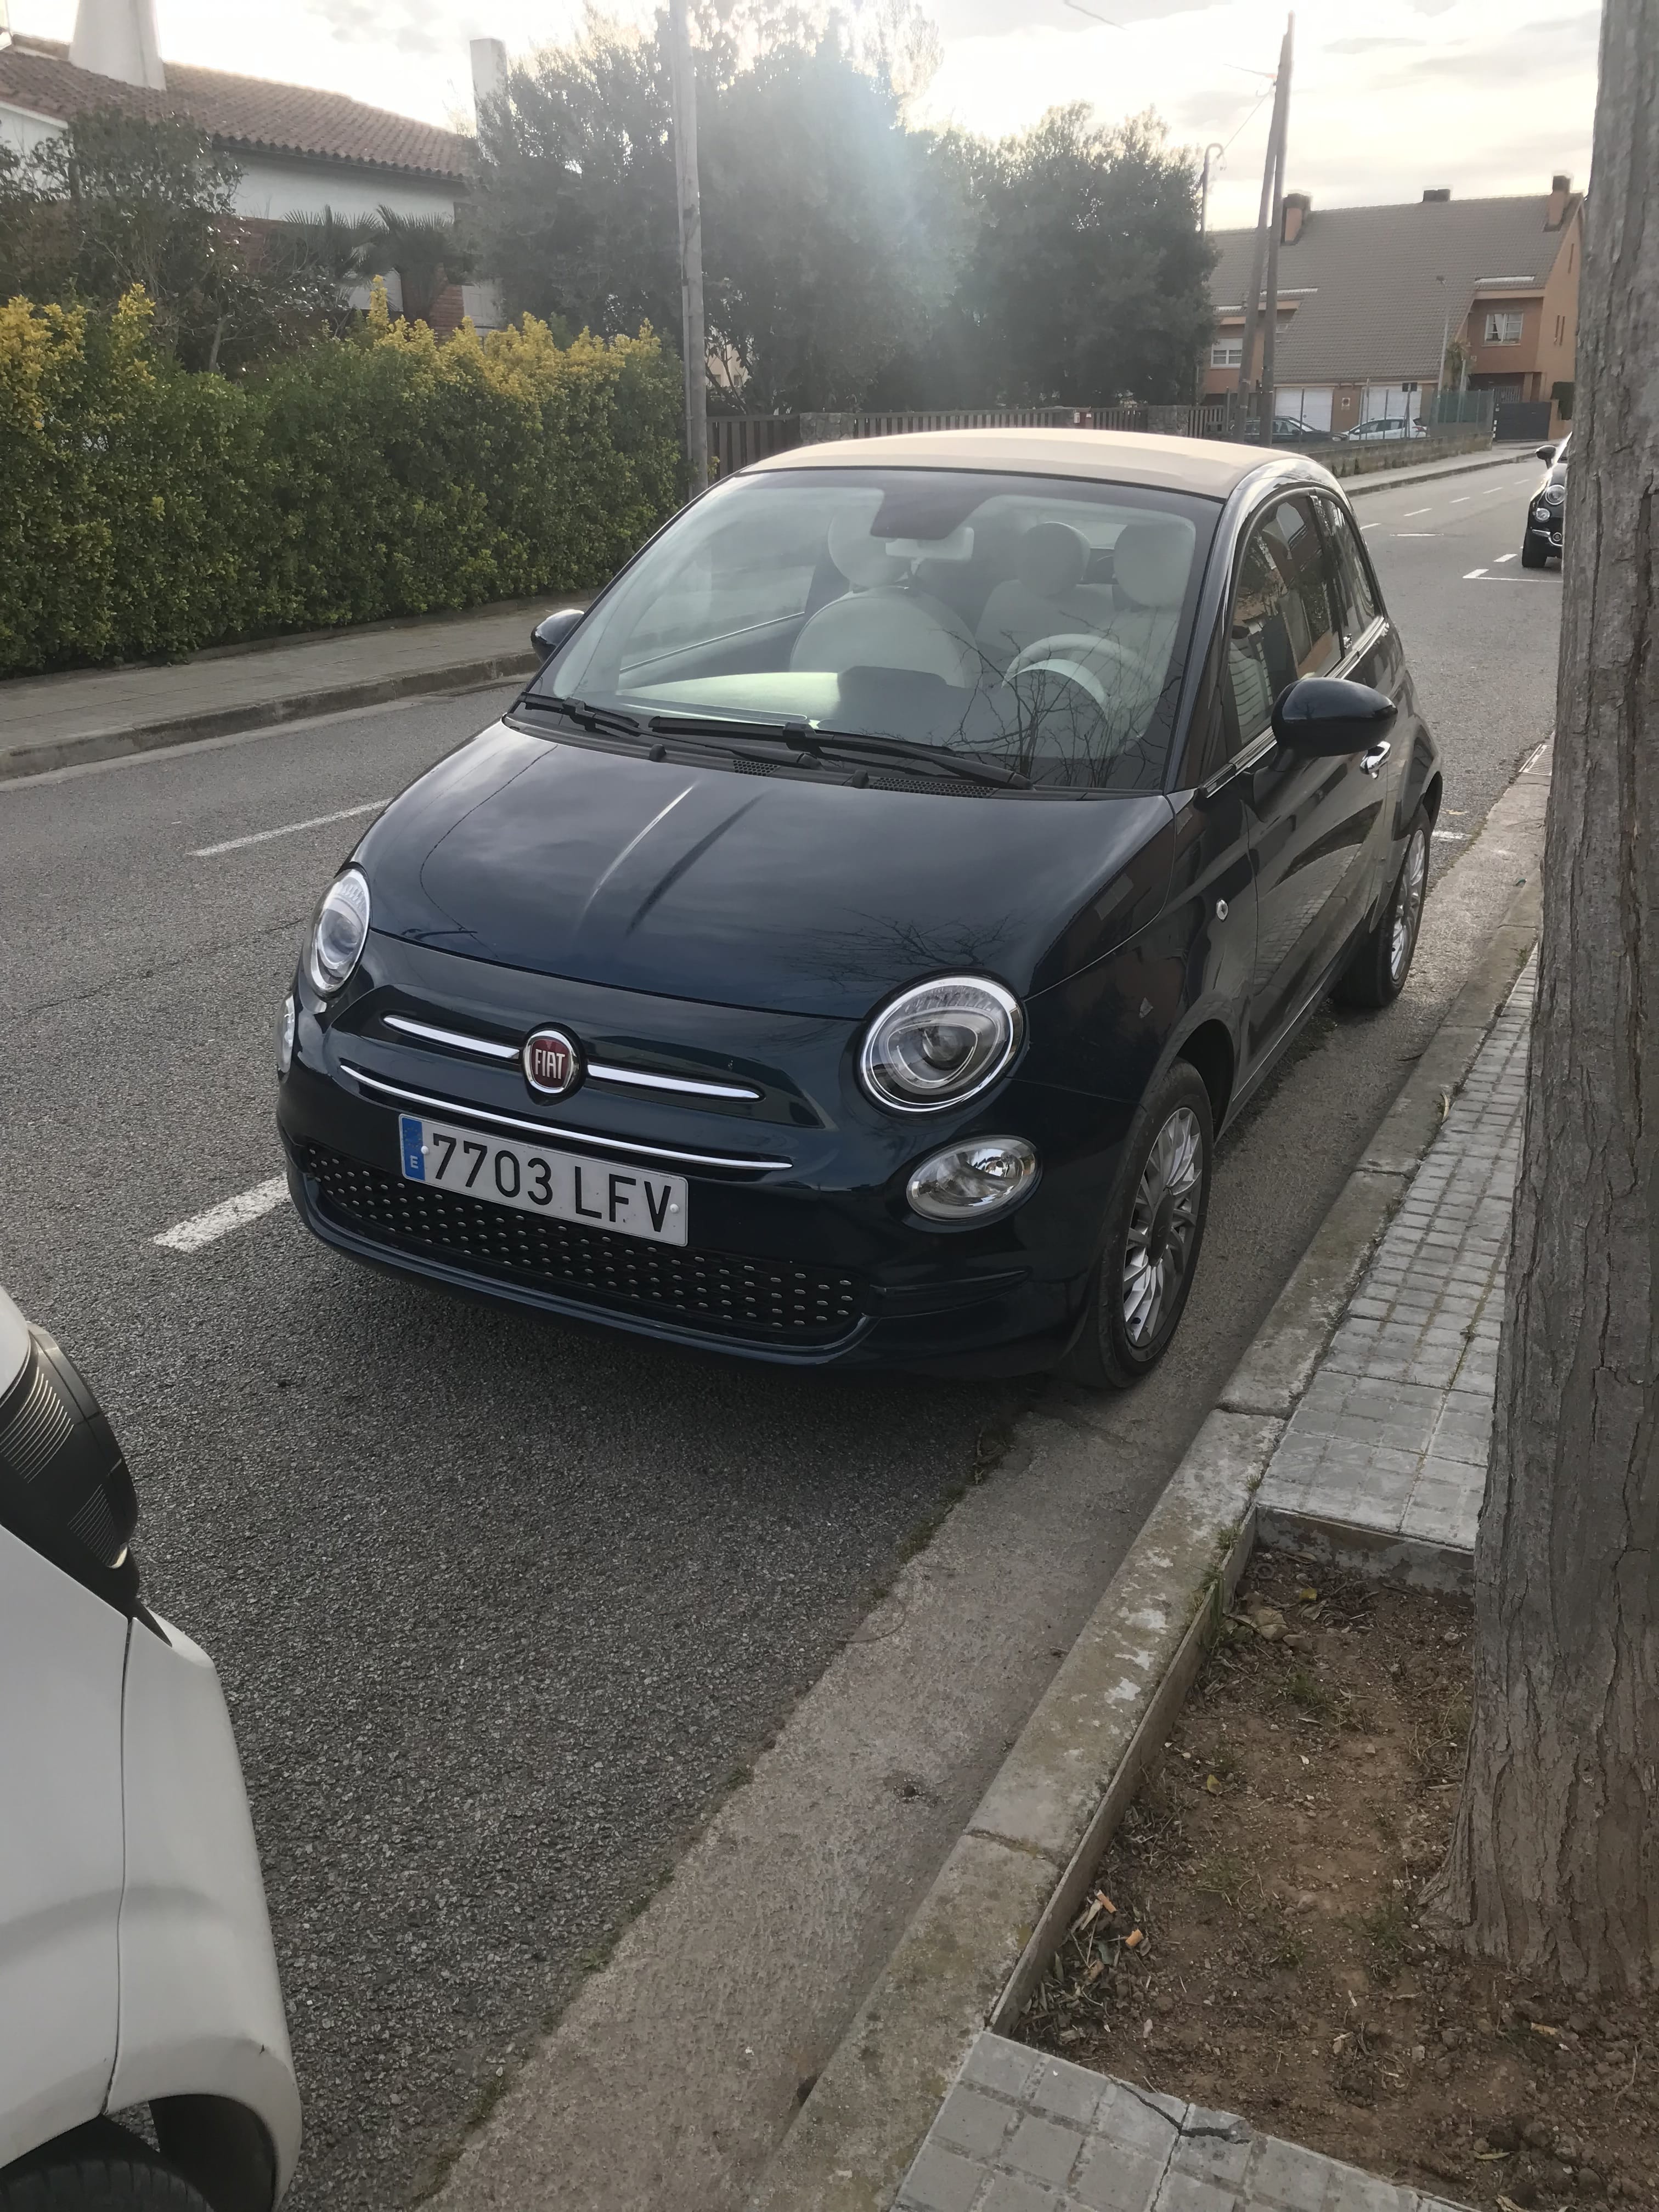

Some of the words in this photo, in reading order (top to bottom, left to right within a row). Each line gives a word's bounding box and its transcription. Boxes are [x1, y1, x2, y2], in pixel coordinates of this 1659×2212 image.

[535, 1049, 566, 1080] FIAT
[410, 1155, 419, 1169] E
[433, 1134, 553, 1205] 7703
[575, 1166, 671, 1232] LFV
